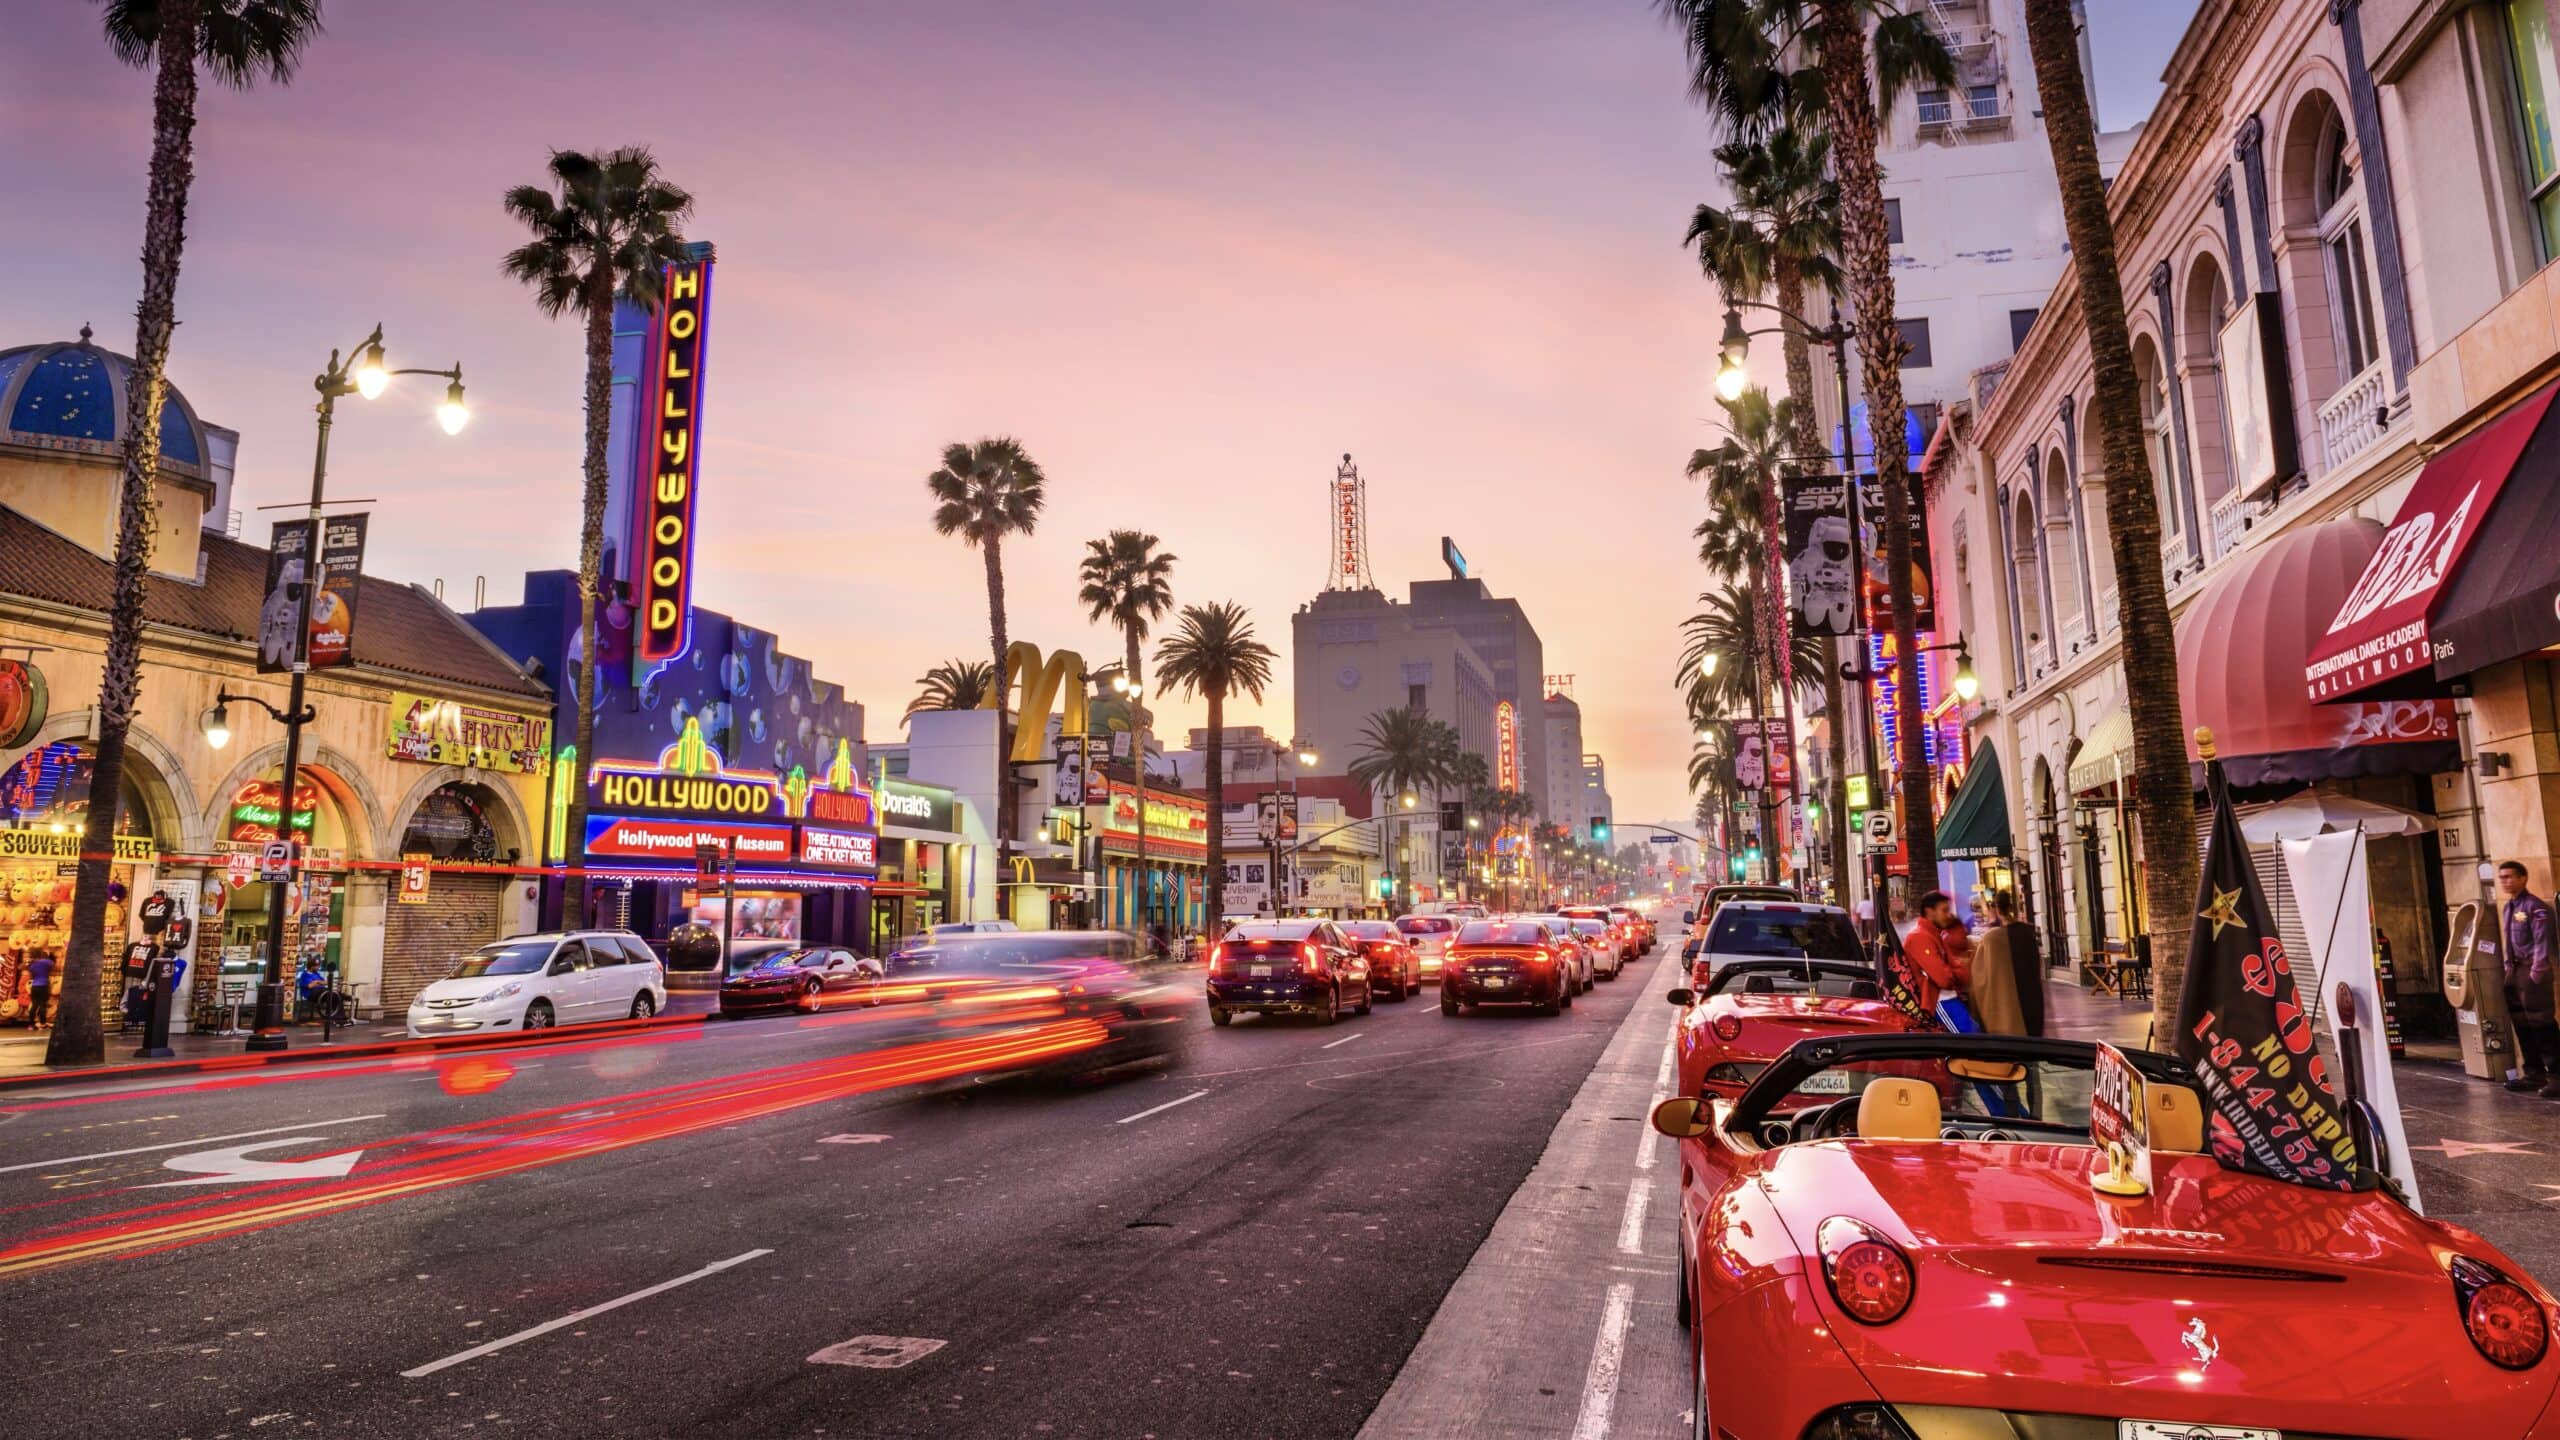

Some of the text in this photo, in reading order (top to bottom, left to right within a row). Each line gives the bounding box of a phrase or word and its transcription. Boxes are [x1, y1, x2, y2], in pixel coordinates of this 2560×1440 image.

[651, 270, 698, 631] HOLLYWOOD
[276, 533, 358, 554] SPCE
[2306, 619, 2425, 681] INTERNATIONAL DANCE ACADEMY
[2434, 639, 2455, 661] Paris
[2308, 641, 2431, 700] HOLLYWOOD
[1501, 719, 1512, 787] CAPITA
[604, 774, 770, 813] HOLLYWOOD
[814, 791, 867, 824] HOLLYWOOD
[4, 833, 151, 859] SOUVENI TLET
[617, 829, 784, 851] Hollywood Wax Museum
[807, 831, 872, 850] THREE ATTRACTIONS
[231, 853, 255, 868] ATM
[311, 847, 329, 858] PASTA
[807, 846, 825, 861] ONE
[825, 848, 849, 863] TICKET
[1941, 847, 1999, 857] CAMERAS GALORE
[404, 867, 424, 891] $5
[1222, 897, 1248, 905] HOTO
[2251, 1033, 2292, 1079] NO
[1803, 1077, 1845, 1090] 6MWC464
[2095, 1051, 2121, 1112] DRIVE
